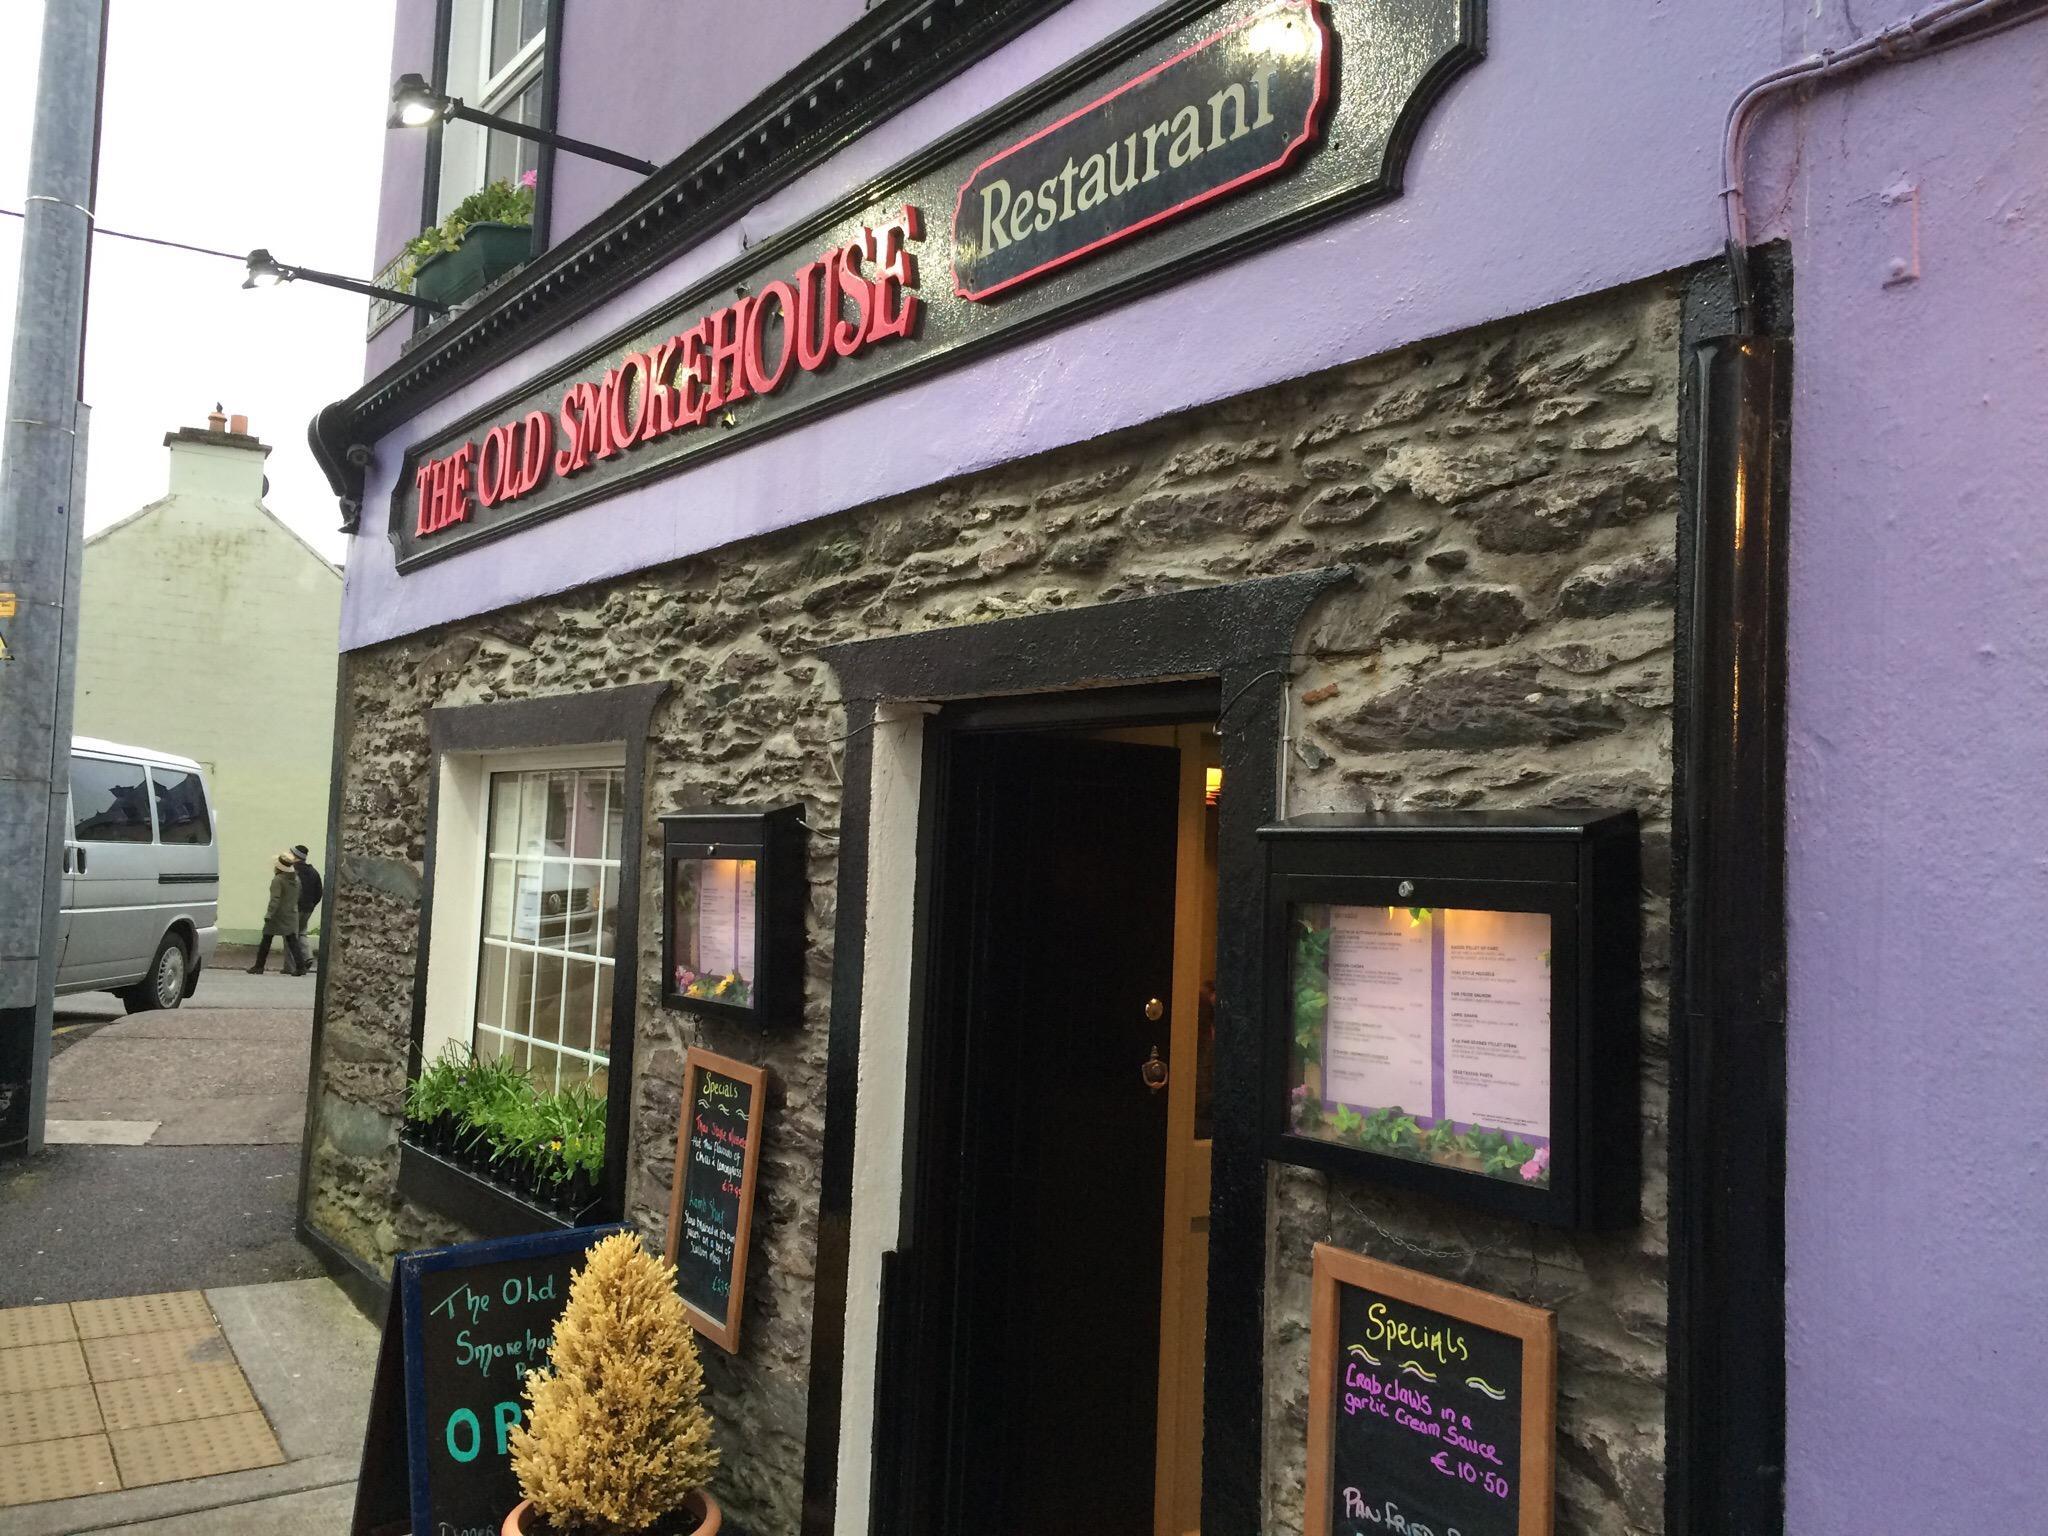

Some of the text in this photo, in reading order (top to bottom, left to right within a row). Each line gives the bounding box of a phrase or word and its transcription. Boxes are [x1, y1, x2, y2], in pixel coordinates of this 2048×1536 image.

[979, 59, 1277, 258] Restaurant
[414, 204, 926, 538] THE OLD SMOKEHOUSE
[703, 1071, 738, 1102] Specials
[430, 1274, 557, 1325] The Old
[456, 1329, 556, 1378] Smokehou
[1344, 1392, 1390, 1417] garlic
[1440, 1408, 1456, 1424] in
[1462, 1415, 1473, 1431] a
[446, 1401, 522, 1463] OP
[1343, 1486, 1382, 1523] PAN
